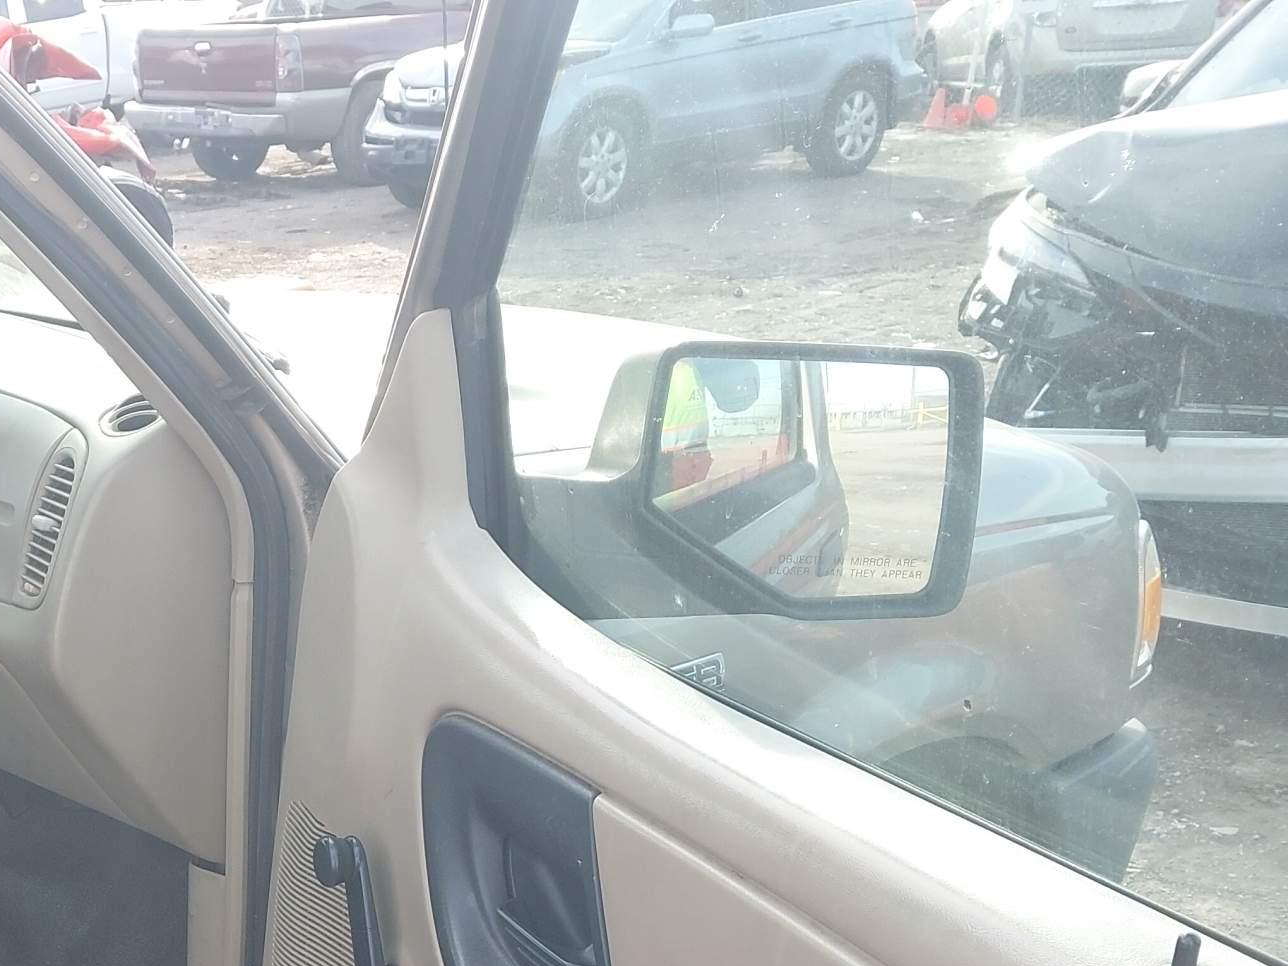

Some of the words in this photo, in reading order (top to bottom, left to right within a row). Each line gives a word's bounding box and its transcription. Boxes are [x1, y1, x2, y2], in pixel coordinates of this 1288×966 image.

[778, 554, 825, 565] OBJECT
[850, 557, 890, 568] MIRROR
[896, 558, 918, 568] ARE
[769, 566, 810, 577] CLOSER
[850, 568, 877, 578] THEY
[881, 569, 922, 580] APPEAR
